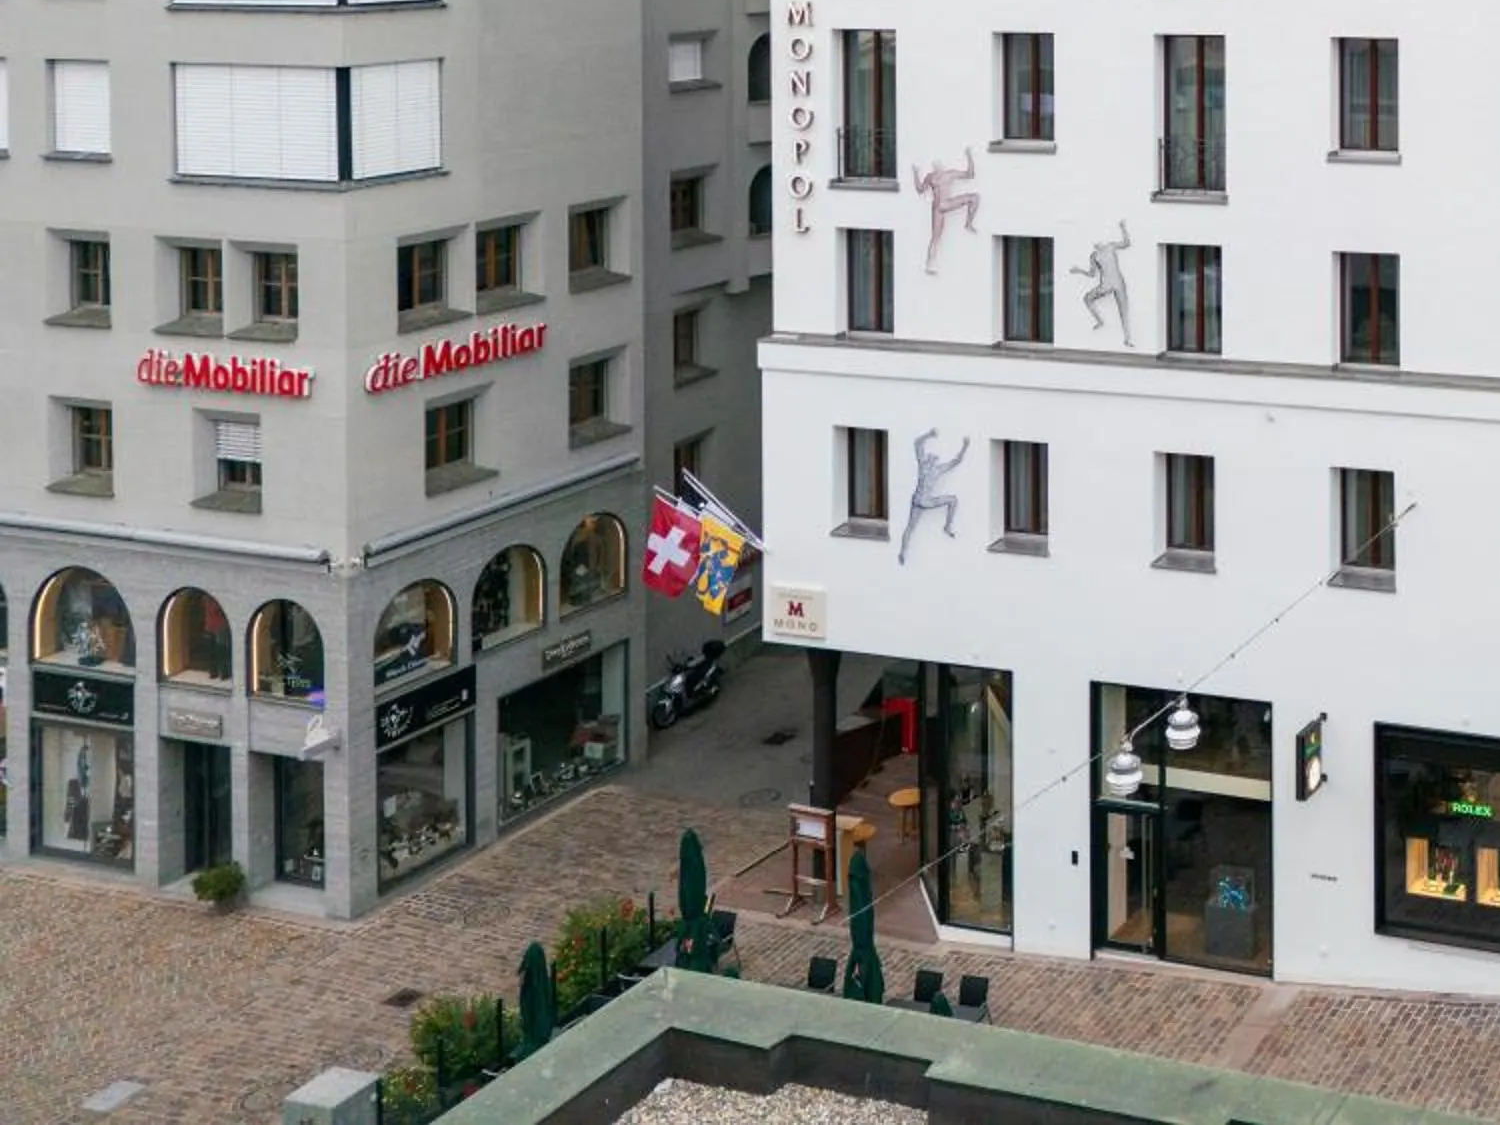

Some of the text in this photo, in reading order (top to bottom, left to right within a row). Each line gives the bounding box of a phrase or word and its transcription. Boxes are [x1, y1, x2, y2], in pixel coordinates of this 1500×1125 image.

[787, 1, 814, 233] MONOPOL
[787, 600, 804, 617] M
[1452, 801, 1493, 817] ROLEX
